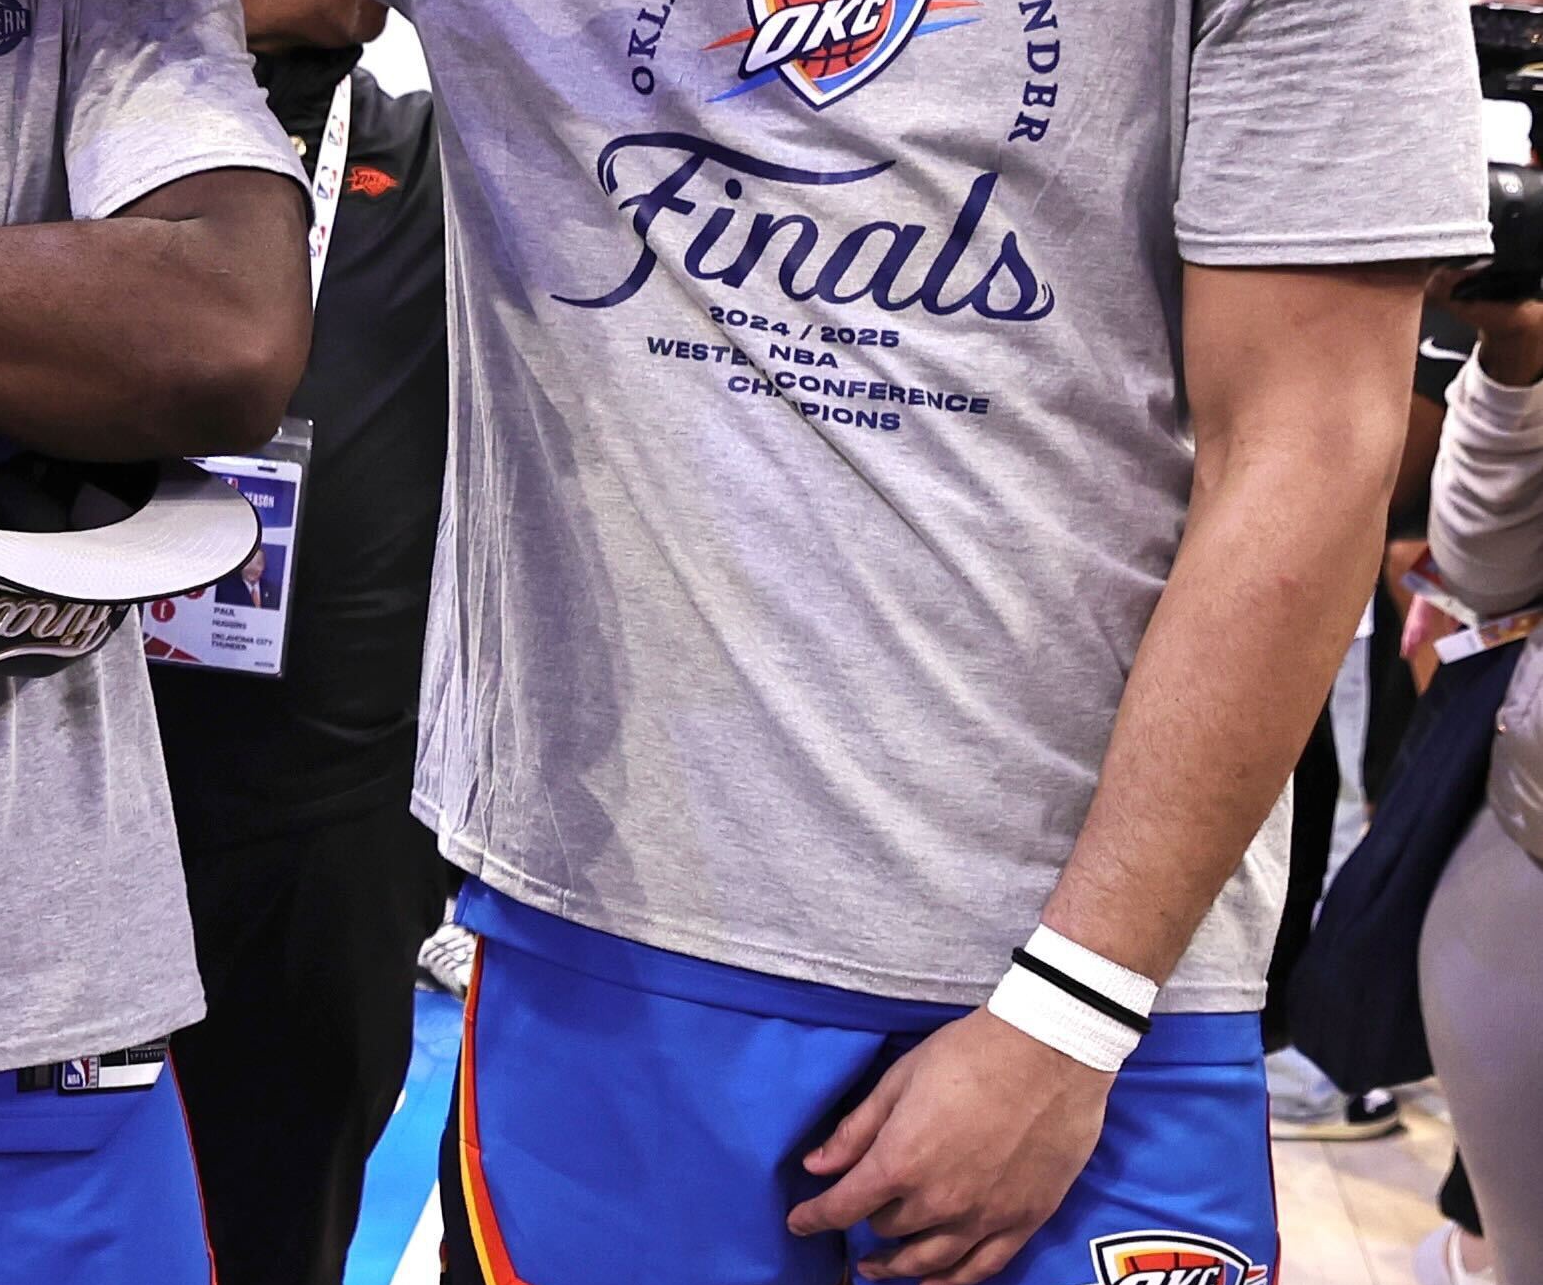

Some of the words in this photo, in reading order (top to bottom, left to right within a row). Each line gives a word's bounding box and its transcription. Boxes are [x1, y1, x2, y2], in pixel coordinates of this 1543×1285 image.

[551, 131, 1055, 322] Finals
[709, 305, 791, 337] 2024
[820, 325, 900, 349] 2025
[647, 336, 758, 367] WESTE
[769, 344, 839, 369] NBA
[774, 371, 991, 415] CONFERENCE
